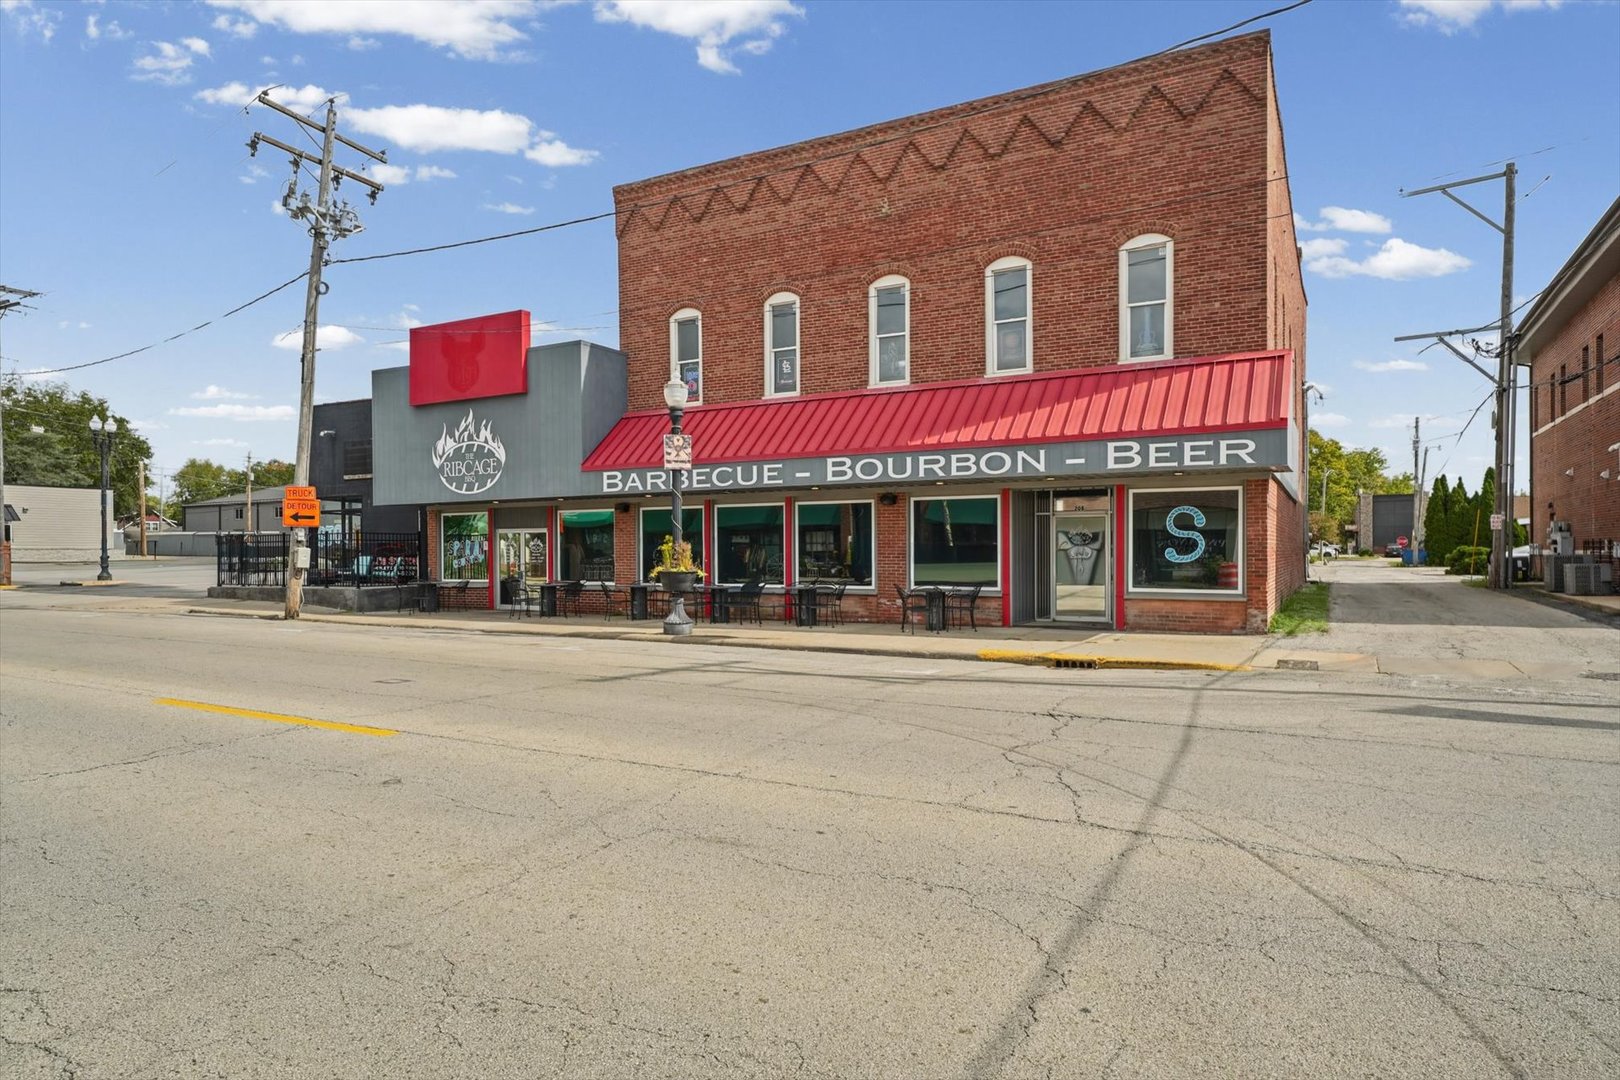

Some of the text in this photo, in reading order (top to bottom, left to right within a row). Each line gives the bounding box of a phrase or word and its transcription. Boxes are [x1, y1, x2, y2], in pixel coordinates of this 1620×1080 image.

[443, 458, 498, 477] RIBCAGE
[826, 449, 1046, 481] BOURBON
[1106, 439, 1257, 469] BEER
[287, 489, 314, 498] TRUCK
[286, 502, 317, 510] DETOUR
[1165, 506, 1206, 563] S
